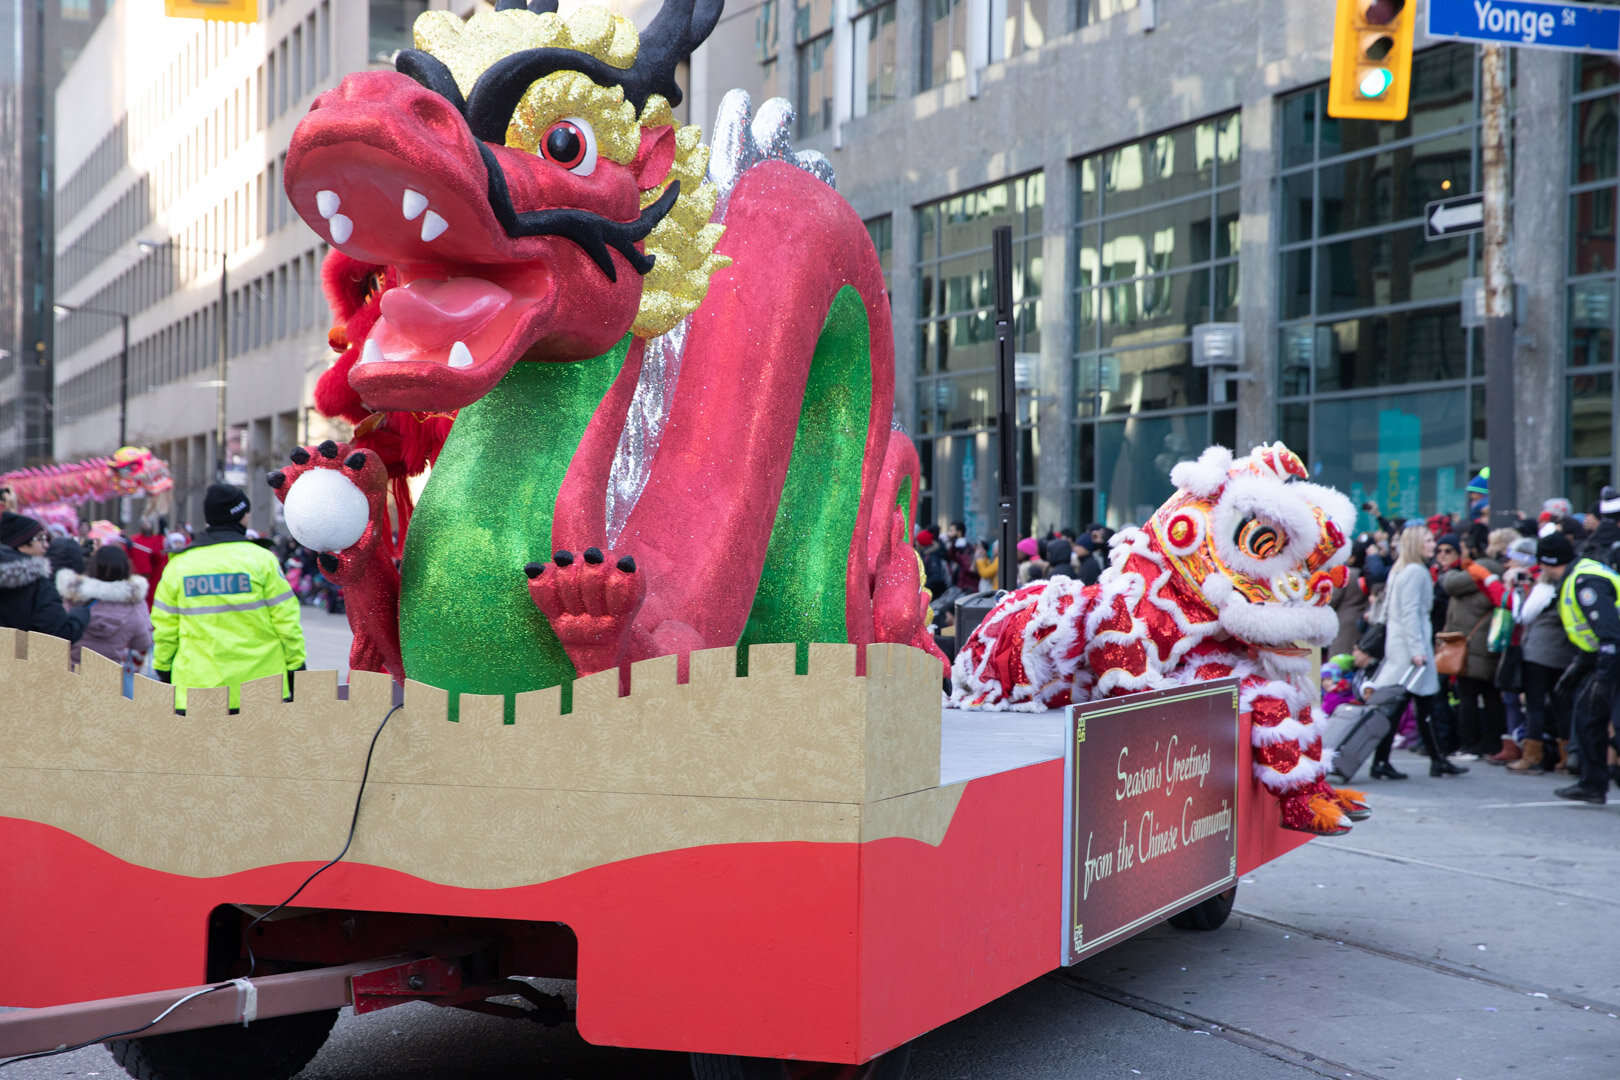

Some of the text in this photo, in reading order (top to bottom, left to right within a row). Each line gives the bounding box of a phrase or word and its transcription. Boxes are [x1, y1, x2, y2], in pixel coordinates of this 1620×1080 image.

[1474, 0, 1577, 43] Yonge St
[1115, 735, 1211, 801] Season's Greetings
[1083, 796, 1232, 901] from the Chinese Community
